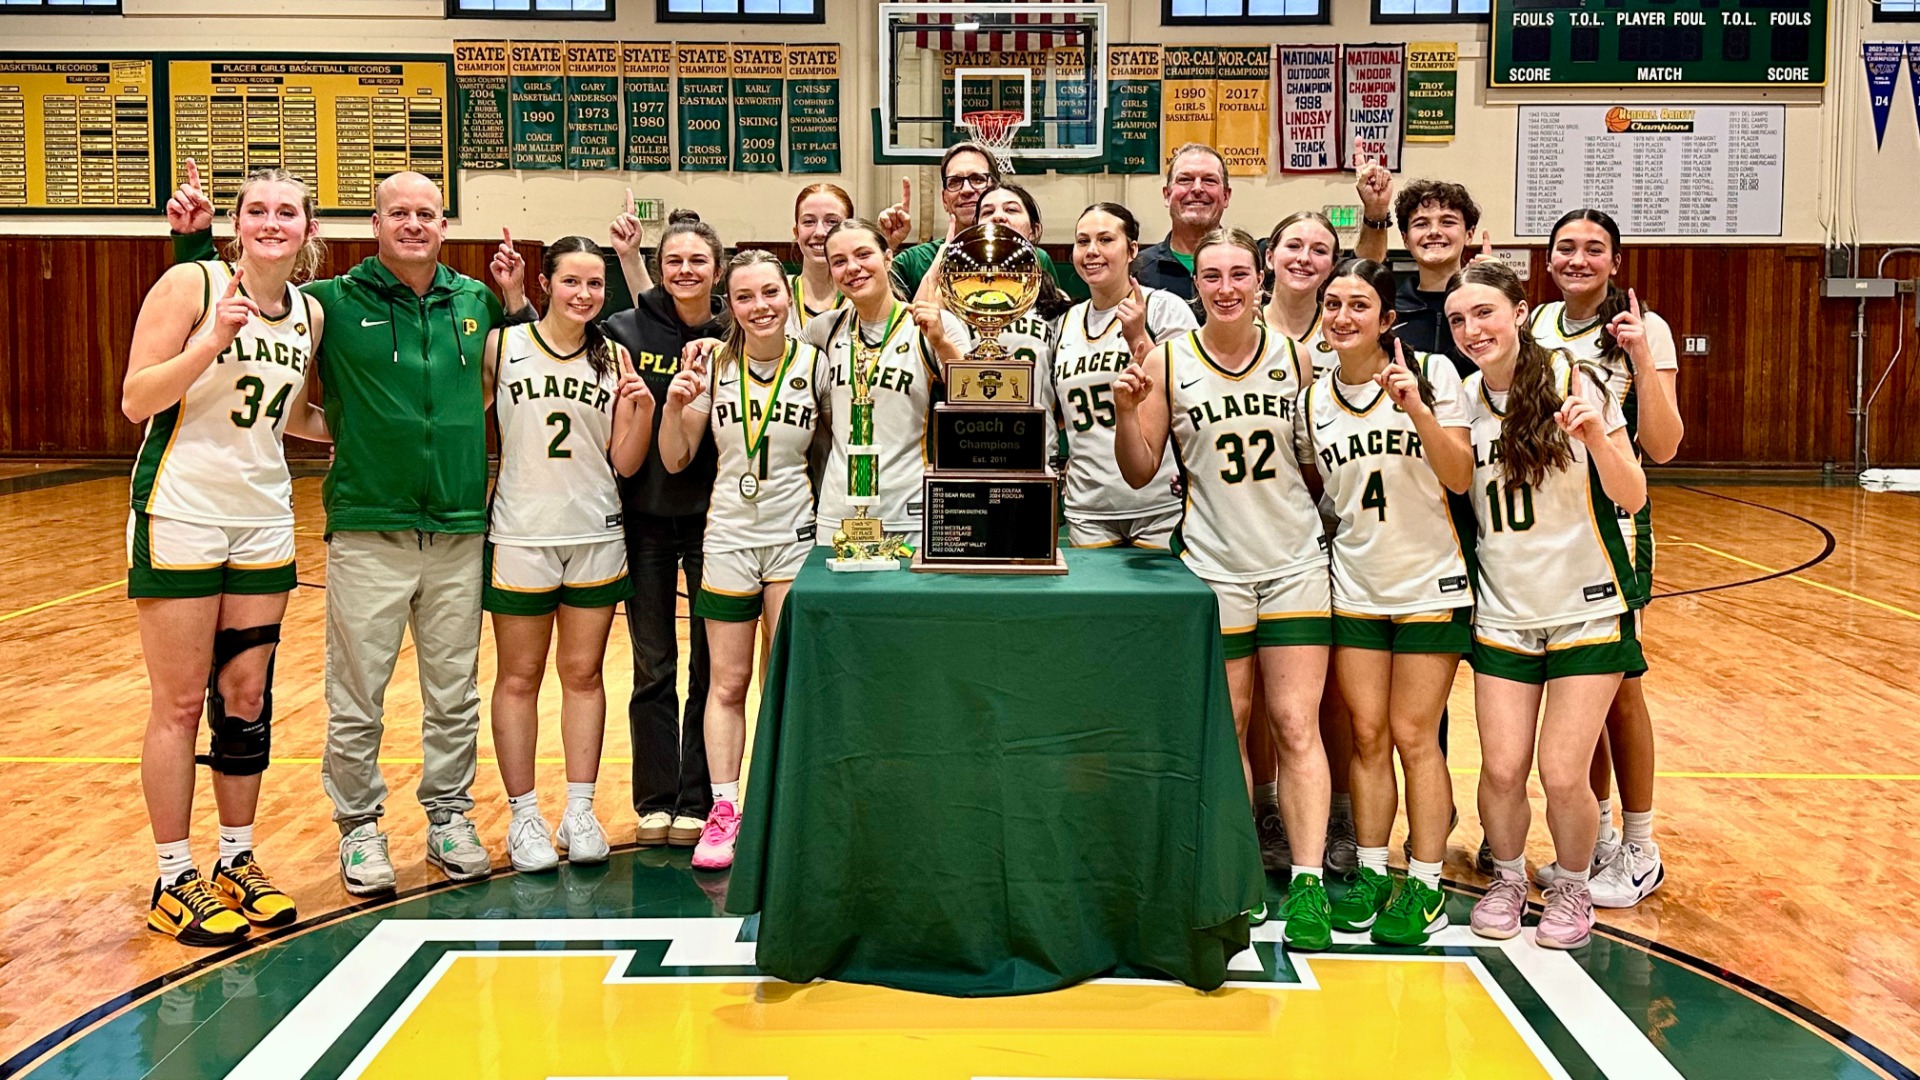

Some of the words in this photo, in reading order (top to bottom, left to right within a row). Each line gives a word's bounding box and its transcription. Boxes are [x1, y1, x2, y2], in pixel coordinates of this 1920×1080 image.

[1513, 13, 1554, 26] FOULS
[1569, 13, 1605, 26] T.O.L.
[1616, 13, 1665, 26] PLAYER
[1674, 13, 1706, 26] FOUL
[1722, 13, 1756, 26] T.O.L.
[1770, 13, 1811, 26] FOULS
[456, 47, 505, 60] STATE
[512, 48, 561, 62] STATE
[568, 48, 616, 62] STATE
[623, 49, 670, 62] STATE
[678, 50, 727, 64] STATE
[734, 50, 782, 64] STATE
[789, 51, 837, 65] STATE
[944, 52, 992, 65] STATE
[1000, 52, 1047, 65] STATE
[1111, 52, 1159, 66] STATE
[1165, 51, 1216, 66] NOR-CAL
[1218, 52, 1269, 66] NOR-CAL
[1283, 51, 1334, 65] NATIONAL
[1347, 50, 1401, 65] NATIONAL
[1410, 52, 1455, 62] STATE
[289, 65, 345, 73] BASKETBALL
[679, 66, 727, 74] CHAMPION
[734, 66, 782, 74] CHAMPION
[1111, 68, 1159, 76] CHAMPION
[1166, 67, 1215, 76] CHAMPIONS
[1218, 68, 1269, 76] CHAMPIONS
[1287, 68, 1330, 80] OUTDOOR
[1356, 68, 1391, 80] INDOOR
[1509, 68, 1551, 81] SCORE
[1637, 68, 1682, 81] MATCH
[1767, 68, 1809, 81] SCORE
[580, 83, 606, 91] GARY
[684, 85, 723, 93] STUART
[745, 85, 772, 93] KARLY
[795, 85, 831, 93] CNISSF
[1120, 86, 1149, 94] CNISF
[1287, 82, 1332, 94] CHAMPION
[1349, 82, 1396, 94] CHAMPION
[469, 90, 495, 98] 2004
[512, 93, 563, 102] BASKETBALL
[568, 94, 618, 102] ANDERSON
[1174, 88, 1206, 99] 1990
[1226, 88, 1259, 99] 2017
[680, 97, 728, 105] EASTMAN
[1121, 100, 1148, 108] GIRLS
[1295, 96, 1322, 110] 1998
[1362, 94, 1388, 108] 1998
[1875, 96, 1888, 106] D4
[632, 102, 664, 113] 1977
[1174, 103, 1206, 111] GIRLS
[1220, 103, 1267, 111] FOOTBALL
[523, 112, 555, 122] 1990
[578, 108, 609, 119] 1973
[1120, 110, 1148, 118] STATE
[1166, 113, 1215, 122] BASKETBALL
[1286, 110, 1332, 125] LINDSAY
[1349, 109, 1394, 123] LINDSAY
[568, 123, 618, 131] WRESTLING
[633, 117, 665, 127] 1980
[688, 120, 720, 130] 2000
[739, 117, 778, 126] SKIING
[1290, 126, 1326, 140] HYATT
[1355, 126, 1389, 139] HYATT
[1630, 123, 1689, 132] Champions
[526, 133, 552, 141] COACH
[580, 136, 607, 144] COACH
[631, 136, 667, 144] COACH
[1121, 132, 1147, 140] TEAM
[529, 144, 564, 152] MALLERY
[742, 139, 775, 149] 2009
[1295, 141, 1325, 153] TRACK
[1362, 142, 1386, 153] RACK
[591, 146, 616, 155] FLAKE
[630, 146, 668, 154] MILLER
[687, 146, 721, 154] CROSS
[1224, 148, 1259, 156] COACH
[516, 154, 533, 162] DON
[535, 154, 562, 162] MEADS
[681, 156, 728, 164] COUNTRY
[742, 153, 775, 164] 2010
[1124, 157, 1145, 165] 1994
[1222, 158, 1266, 166] ONTOYA
[1290, 154, 1312, 167] 800
[1319, 153, 1327, 167] M
[634, 201, 653, 218] XIT
[639, 351, 678, 374] PLA
[1056, 351, 1132, 387] PLACER
[830, 364, 914, 396] PLCER
[508, 376, 611, 414] PLACER
[231, 375, 293, 431] 34
[1068, 384, 1116, 432] 35
[715, 400, 812, 430] PLACER
[1187, 393, 1292, 432] PLACER
[954, 418, 1003, 435] Coach
[1014, 420, 1026, 435] G
[546, 412, 572, 458] 2
[959, 440, 1020, 451] Champions
[1319, 429, 1422, 473] PLACER
[757, 435, 770, 480] 1
[1214, 429, 1276, 485] 32
[1361, 469, 1387, 522] 4
[1486, 480, 1535, 532] 10
